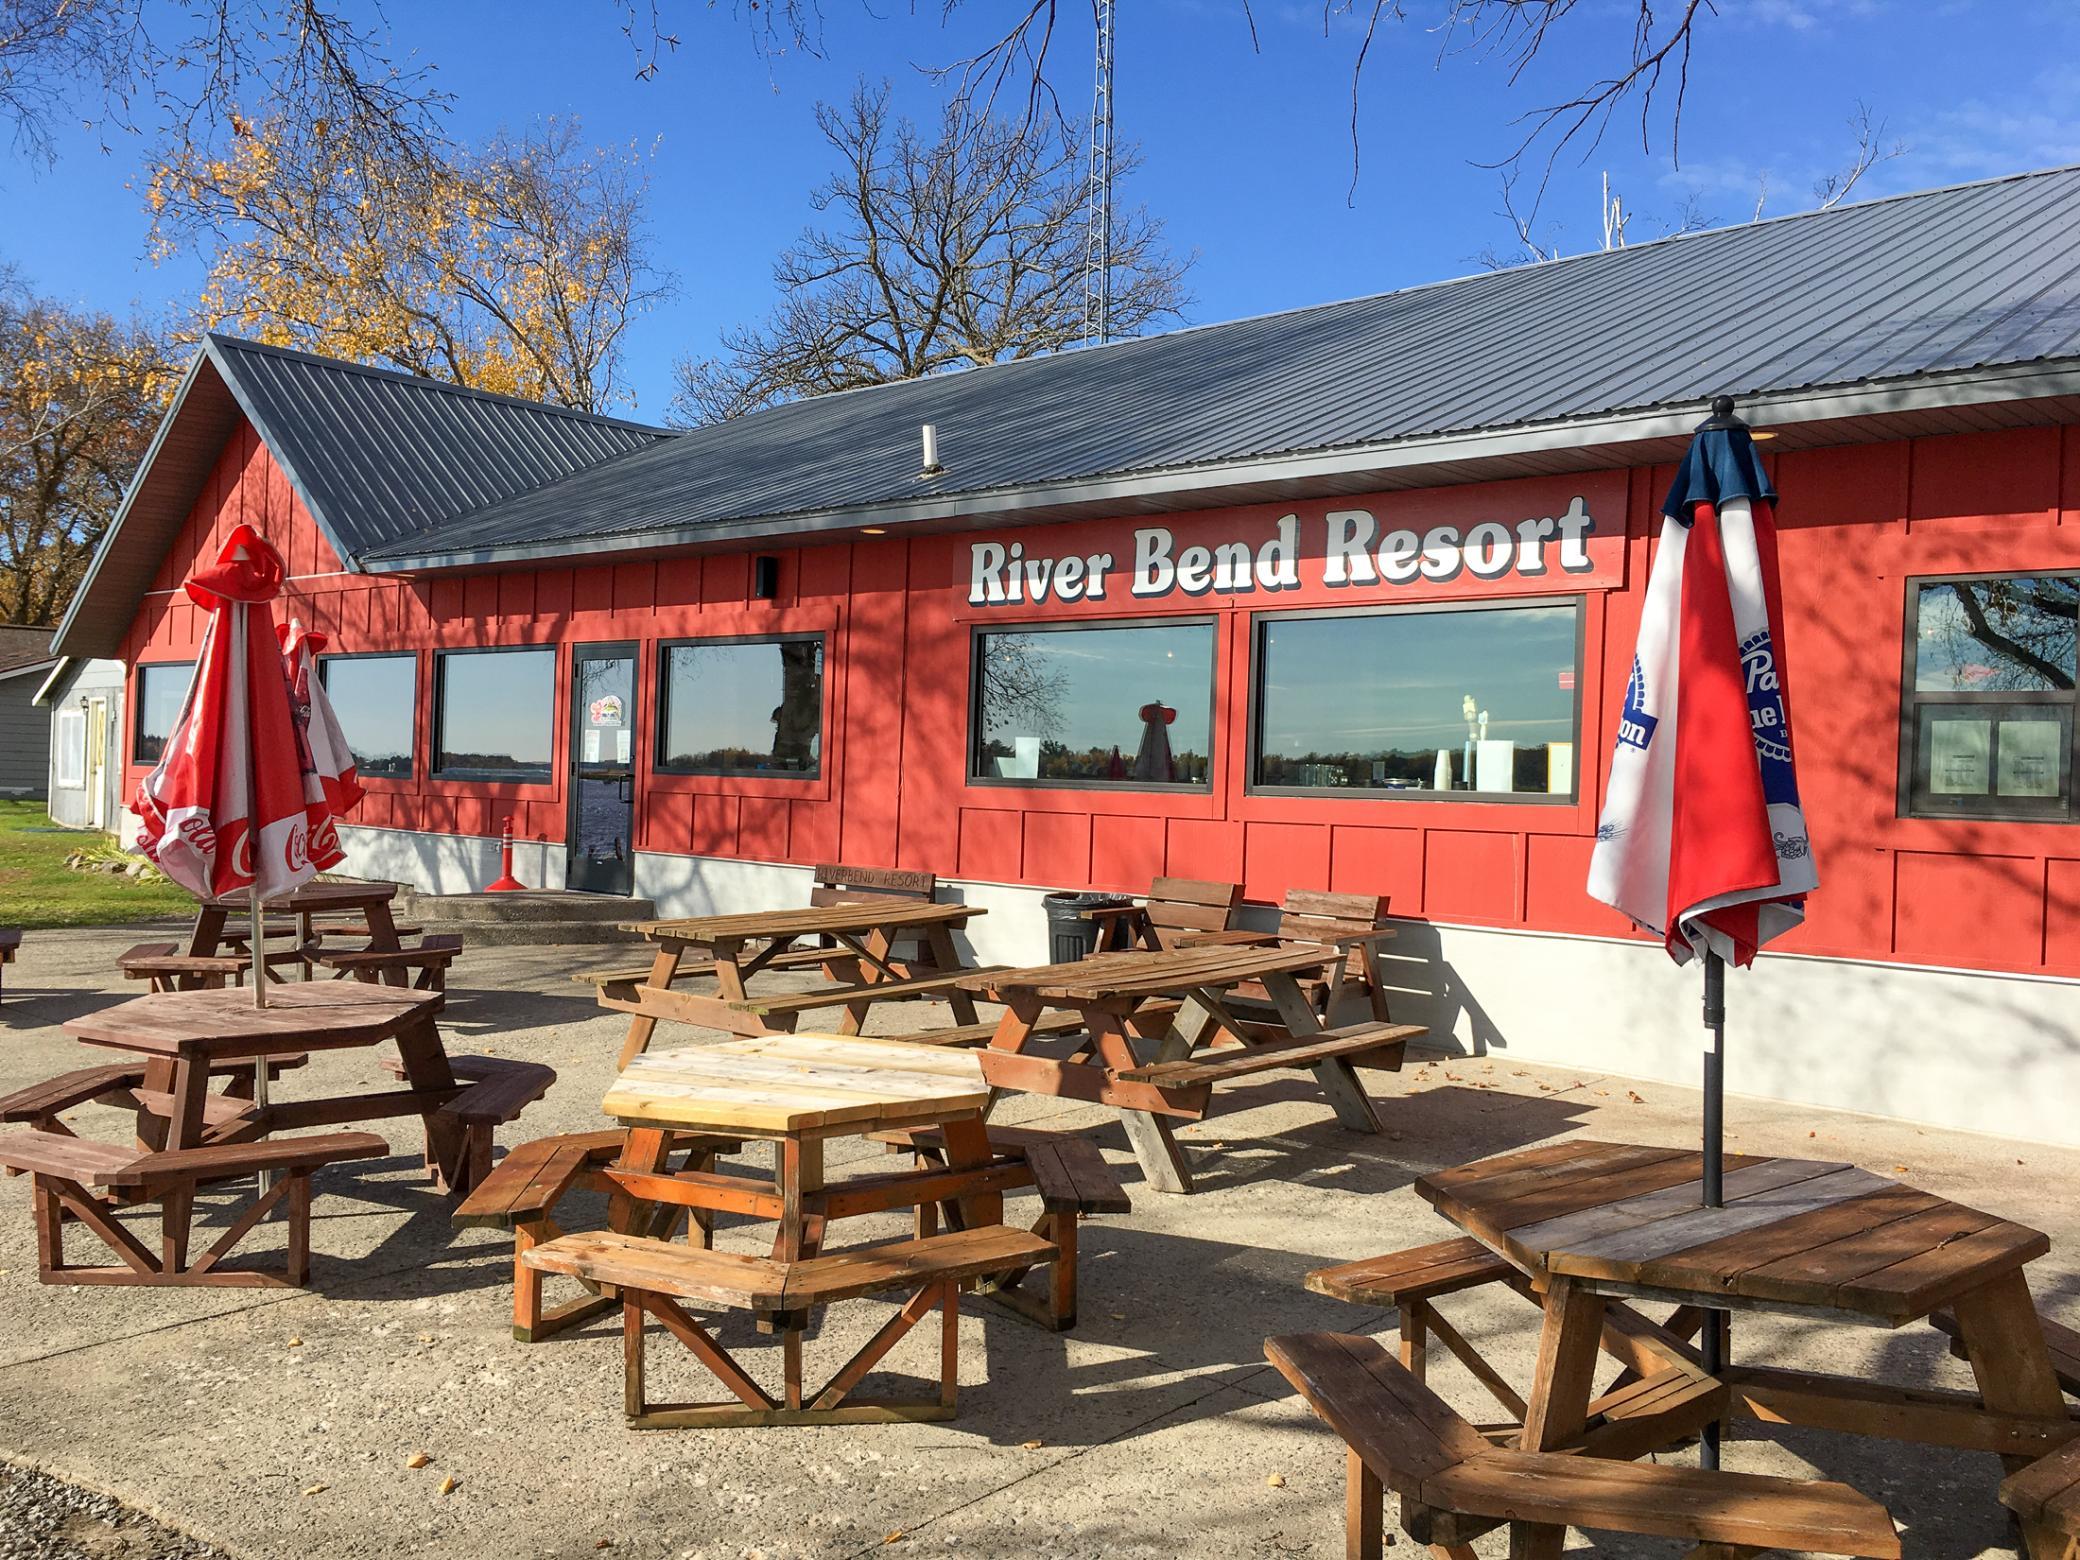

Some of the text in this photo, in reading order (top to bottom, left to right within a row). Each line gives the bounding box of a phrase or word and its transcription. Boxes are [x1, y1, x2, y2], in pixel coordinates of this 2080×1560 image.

[968, 496, 1596, 606] River Bend Resort
[883, 872, 928, 888] RESORT
